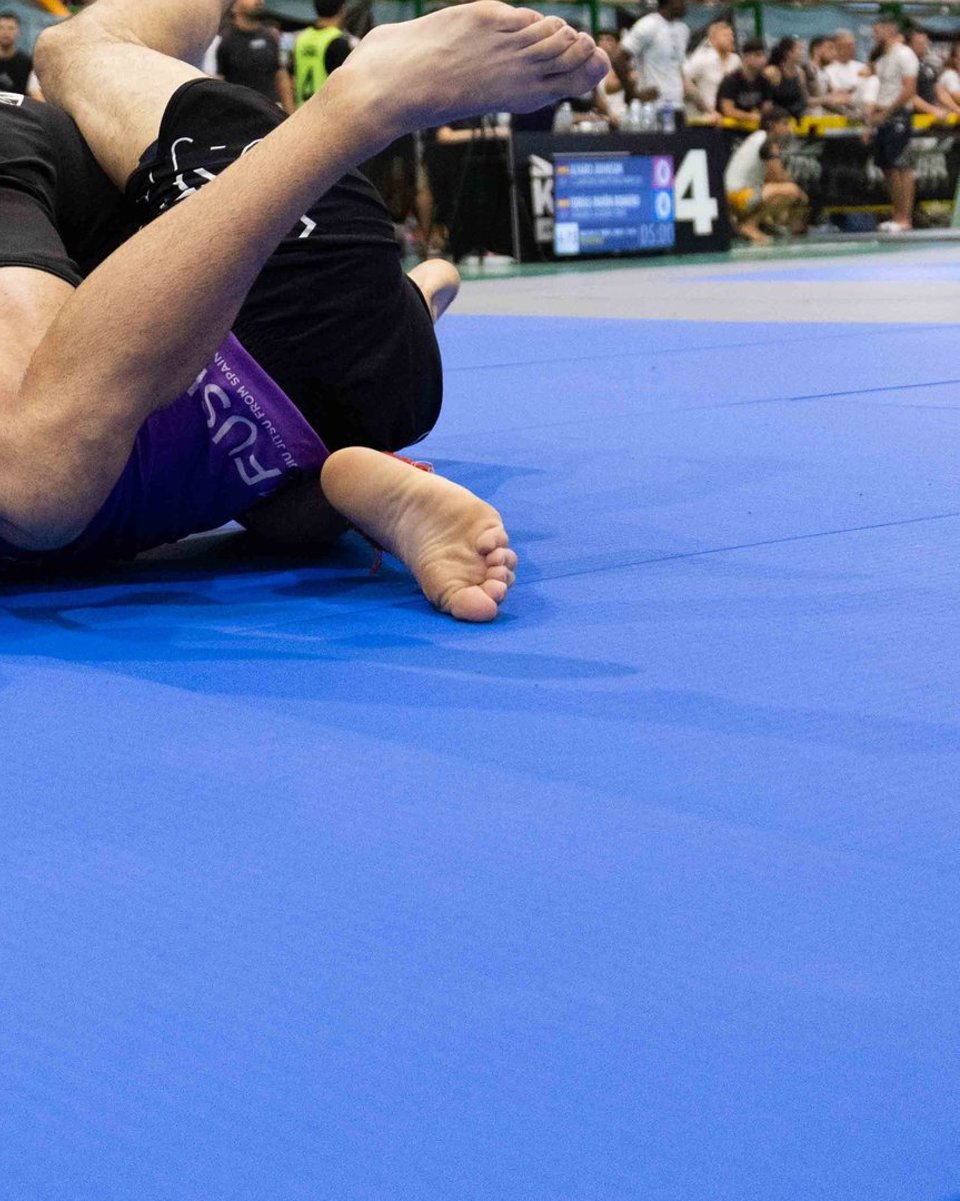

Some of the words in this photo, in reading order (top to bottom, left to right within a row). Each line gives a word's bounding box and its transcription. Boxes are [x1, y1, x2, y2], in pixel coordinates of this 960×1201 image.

[658, 161, 670, 184] 0
[656, 191, 671, 220] 0
[675, 149, 718, 235] 4
[235, 384, 265, 420] FROM
[261, 421, 287, 452] JITSU
